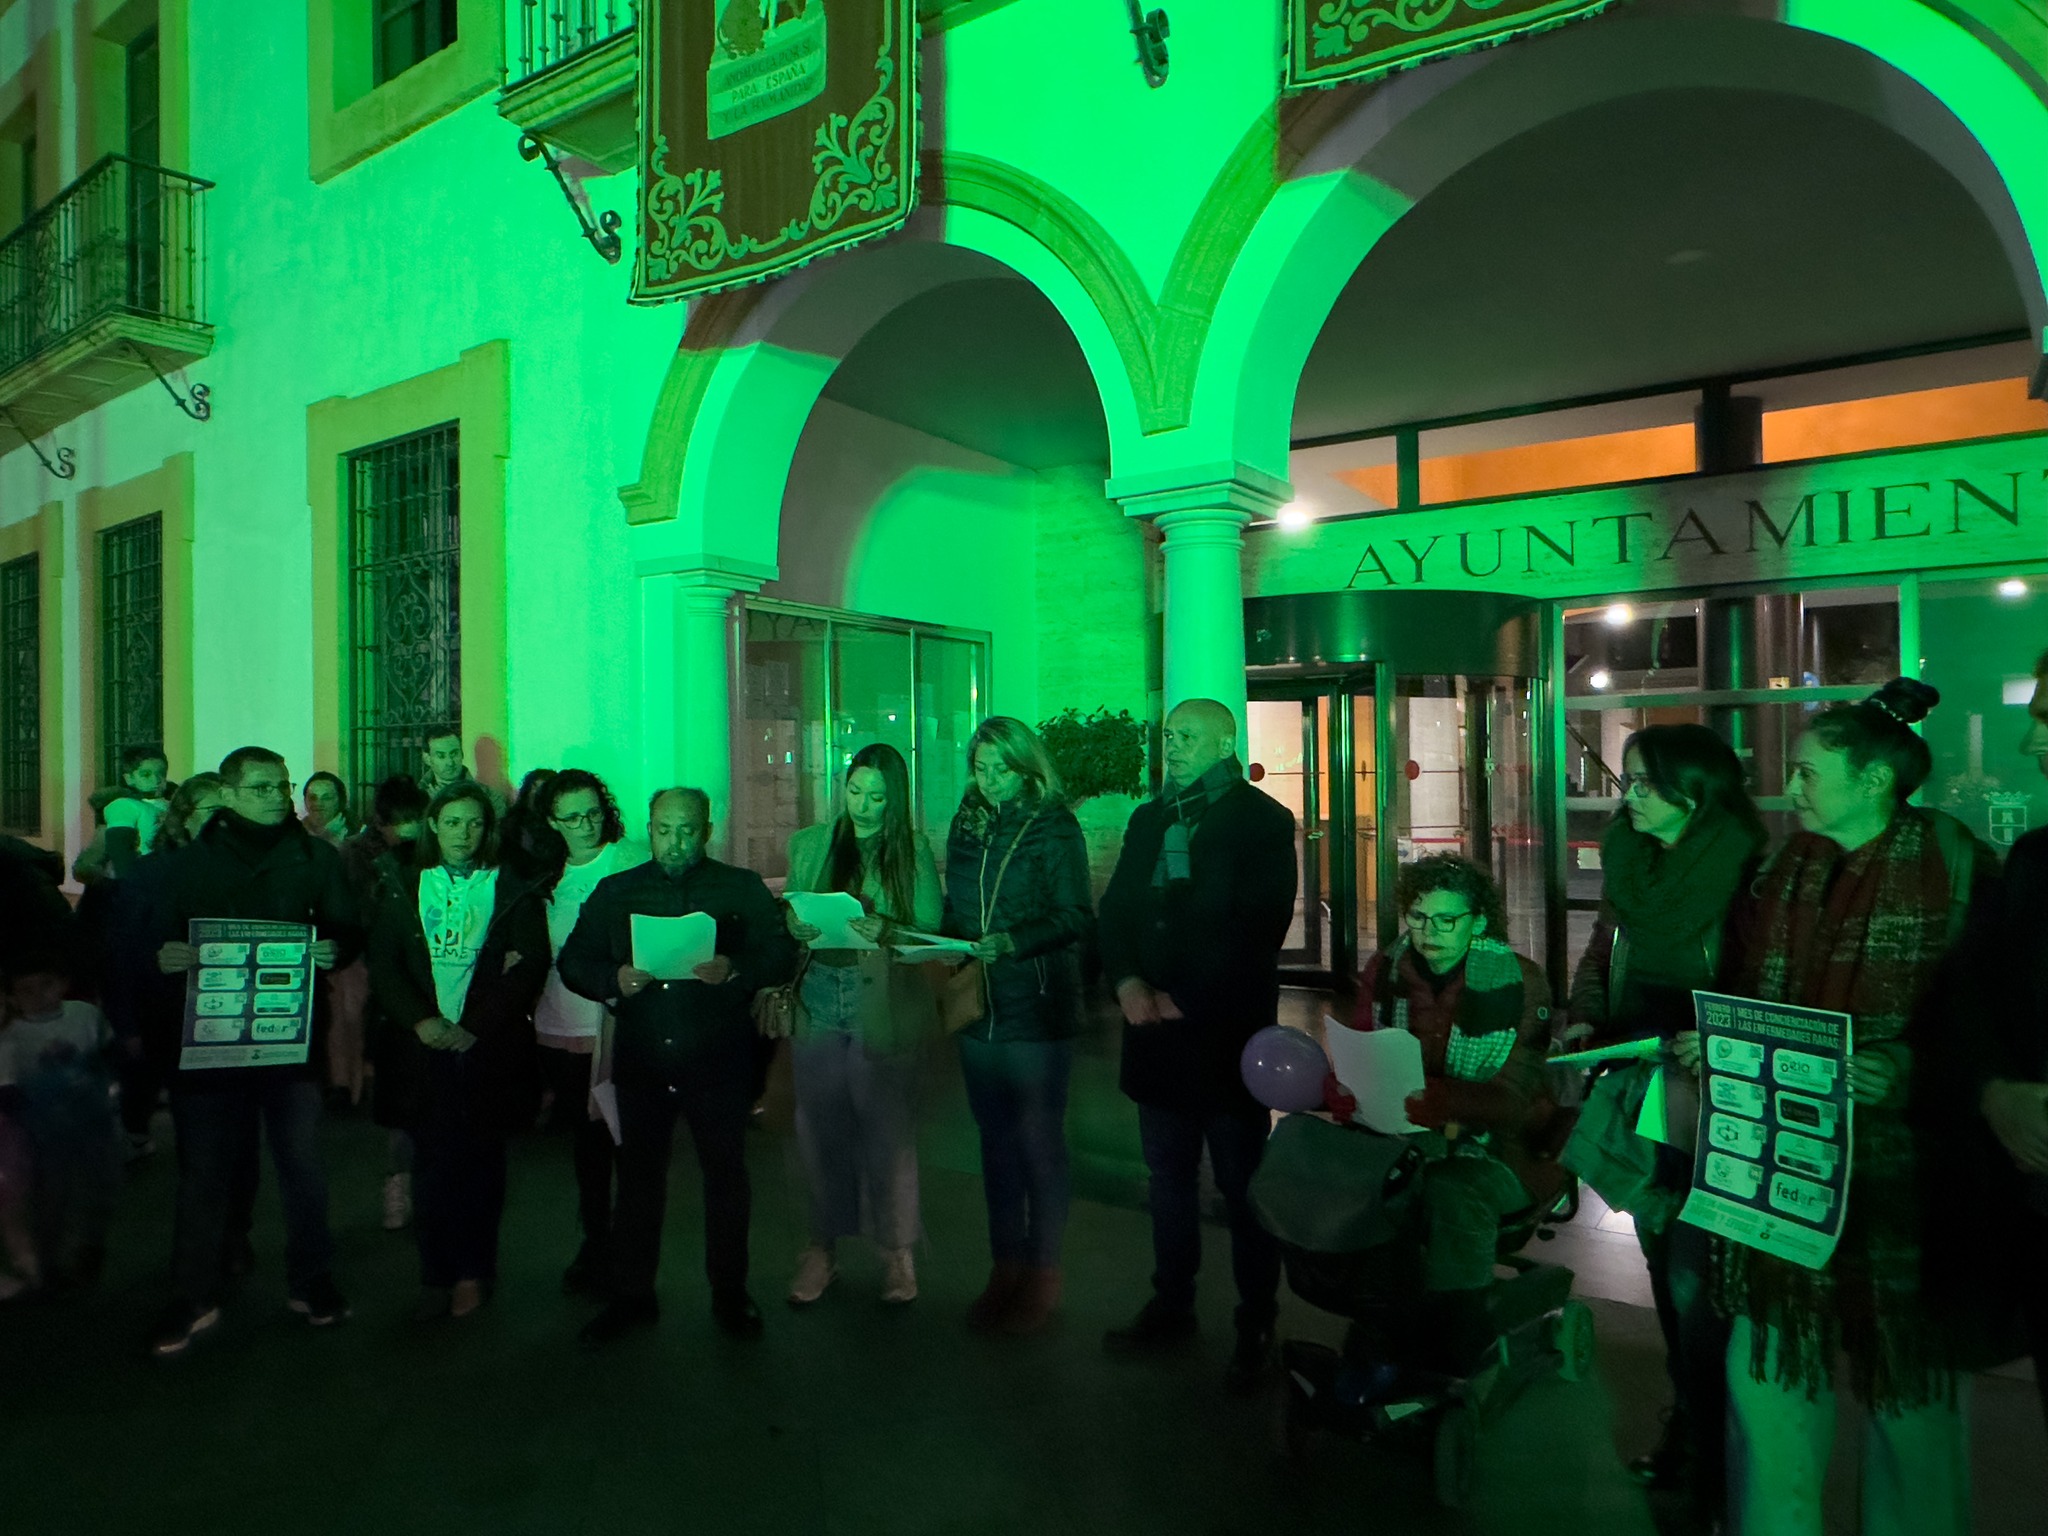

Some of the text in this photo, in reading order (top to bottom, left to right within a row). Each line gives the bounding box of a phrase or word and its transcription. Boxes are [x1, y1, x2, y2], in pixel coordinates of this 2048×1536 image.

[732, 83, 758, 104] PARA
[1347, 468, 2048, 590] AYUNTAMIEN
[1706, 1011, 1731, 1028] 2023
[1753, 1010, 1765, 1023] DE
[1737, 1020, 1752, 1033] LAS
